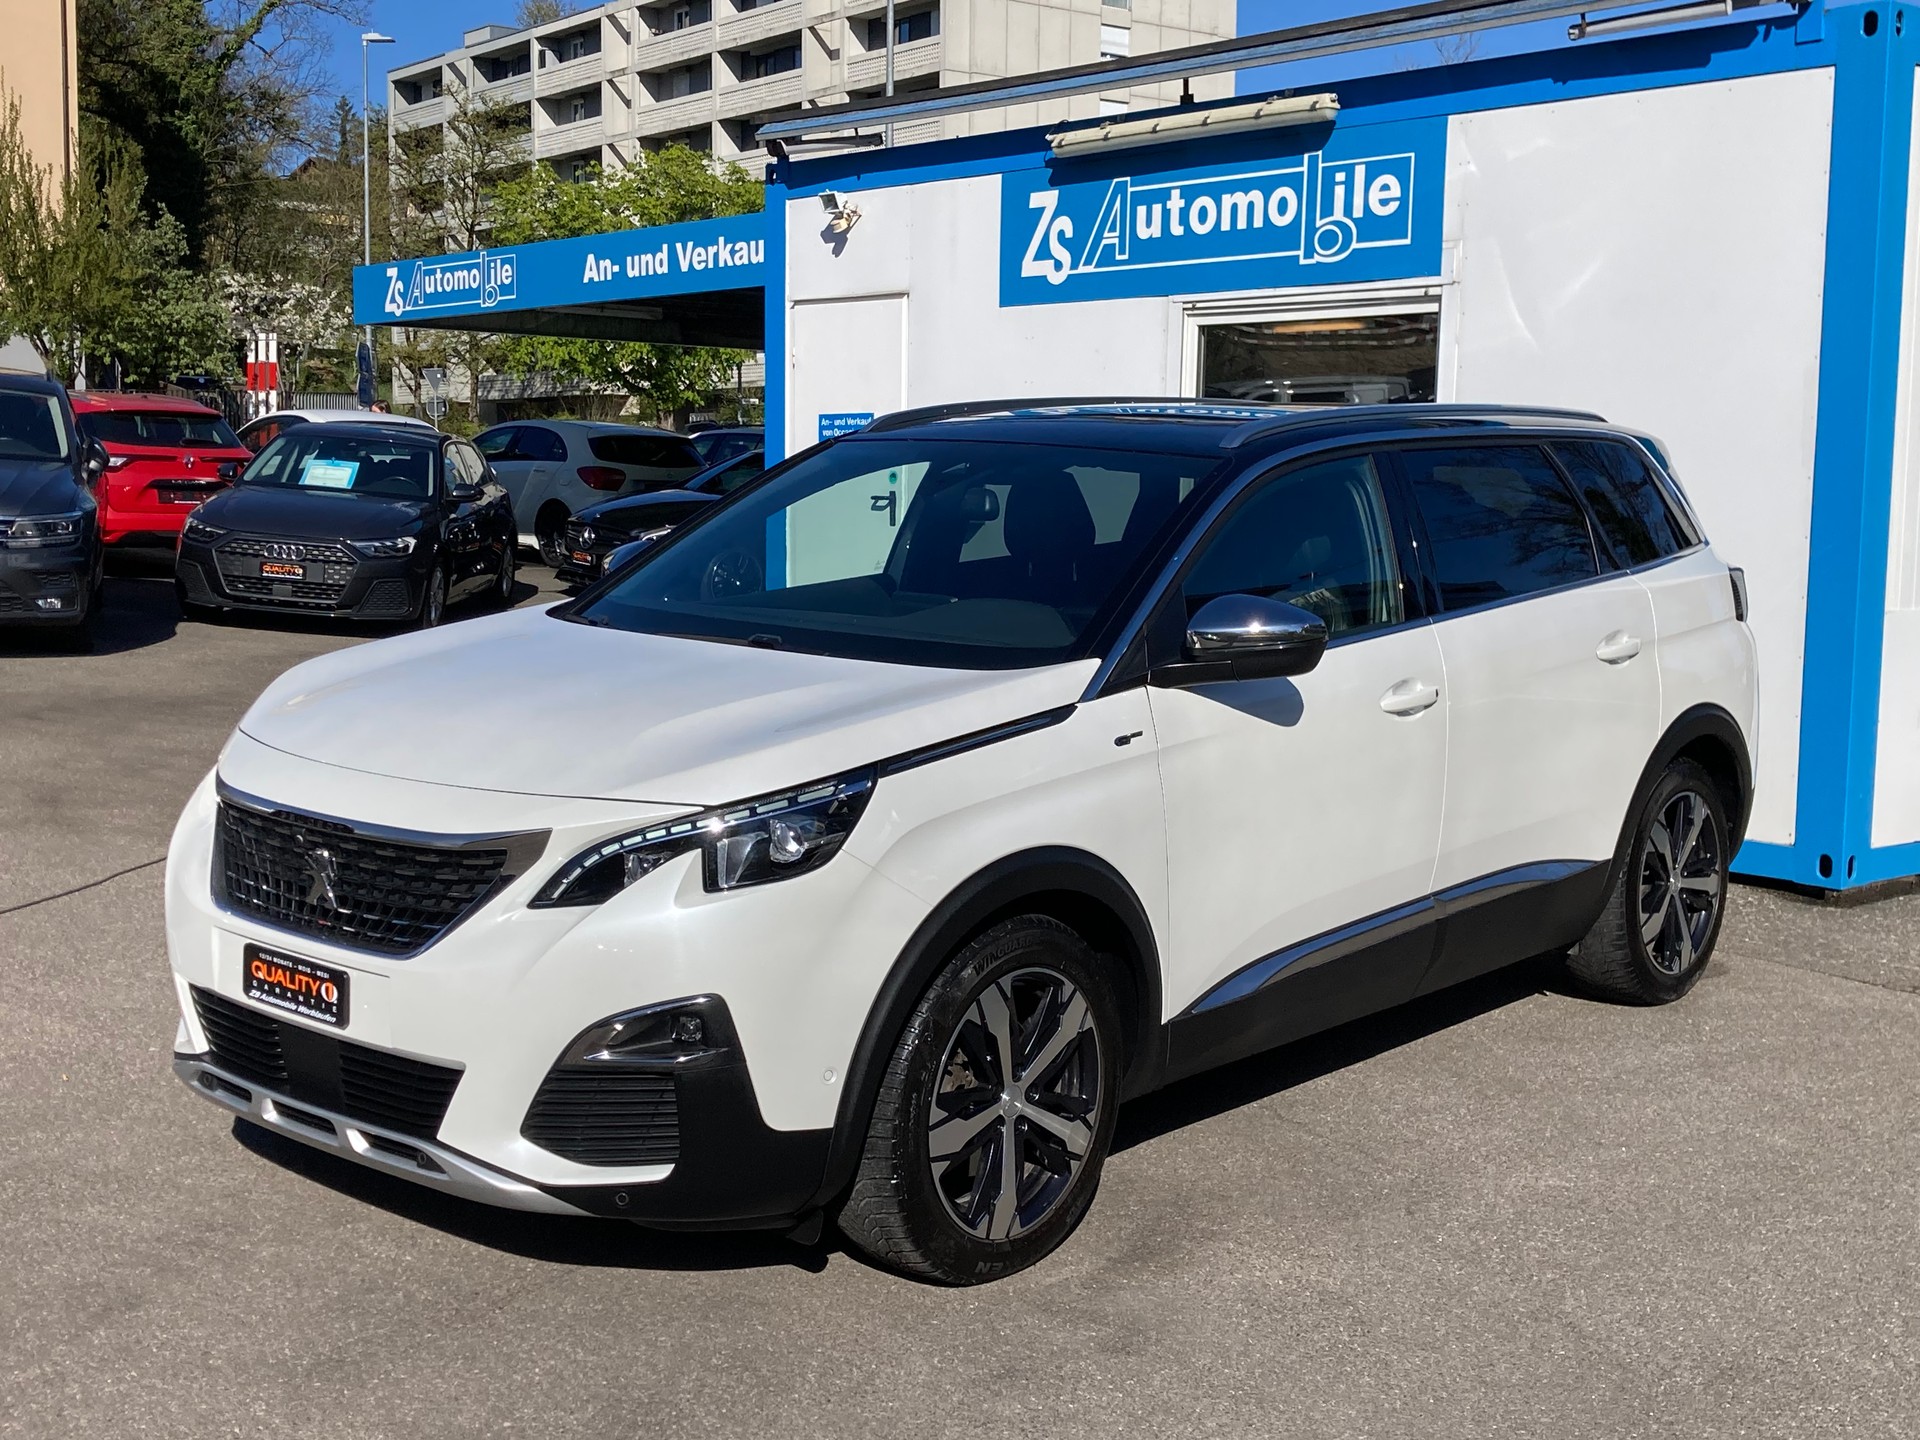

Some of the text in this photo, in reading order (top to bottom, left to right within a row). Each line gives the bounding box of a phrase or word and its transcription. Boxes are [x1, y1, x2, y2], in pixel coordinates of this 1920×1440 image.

[1078, 150, 1402, 271] Automobile
[406, 251, 513, 309] Automobile
[583, 253, 620, 284] An-
[626, 243, 668, 278] und
[834, 418, 845, 426] und
[251, 960, 321, 997] QUALITY
